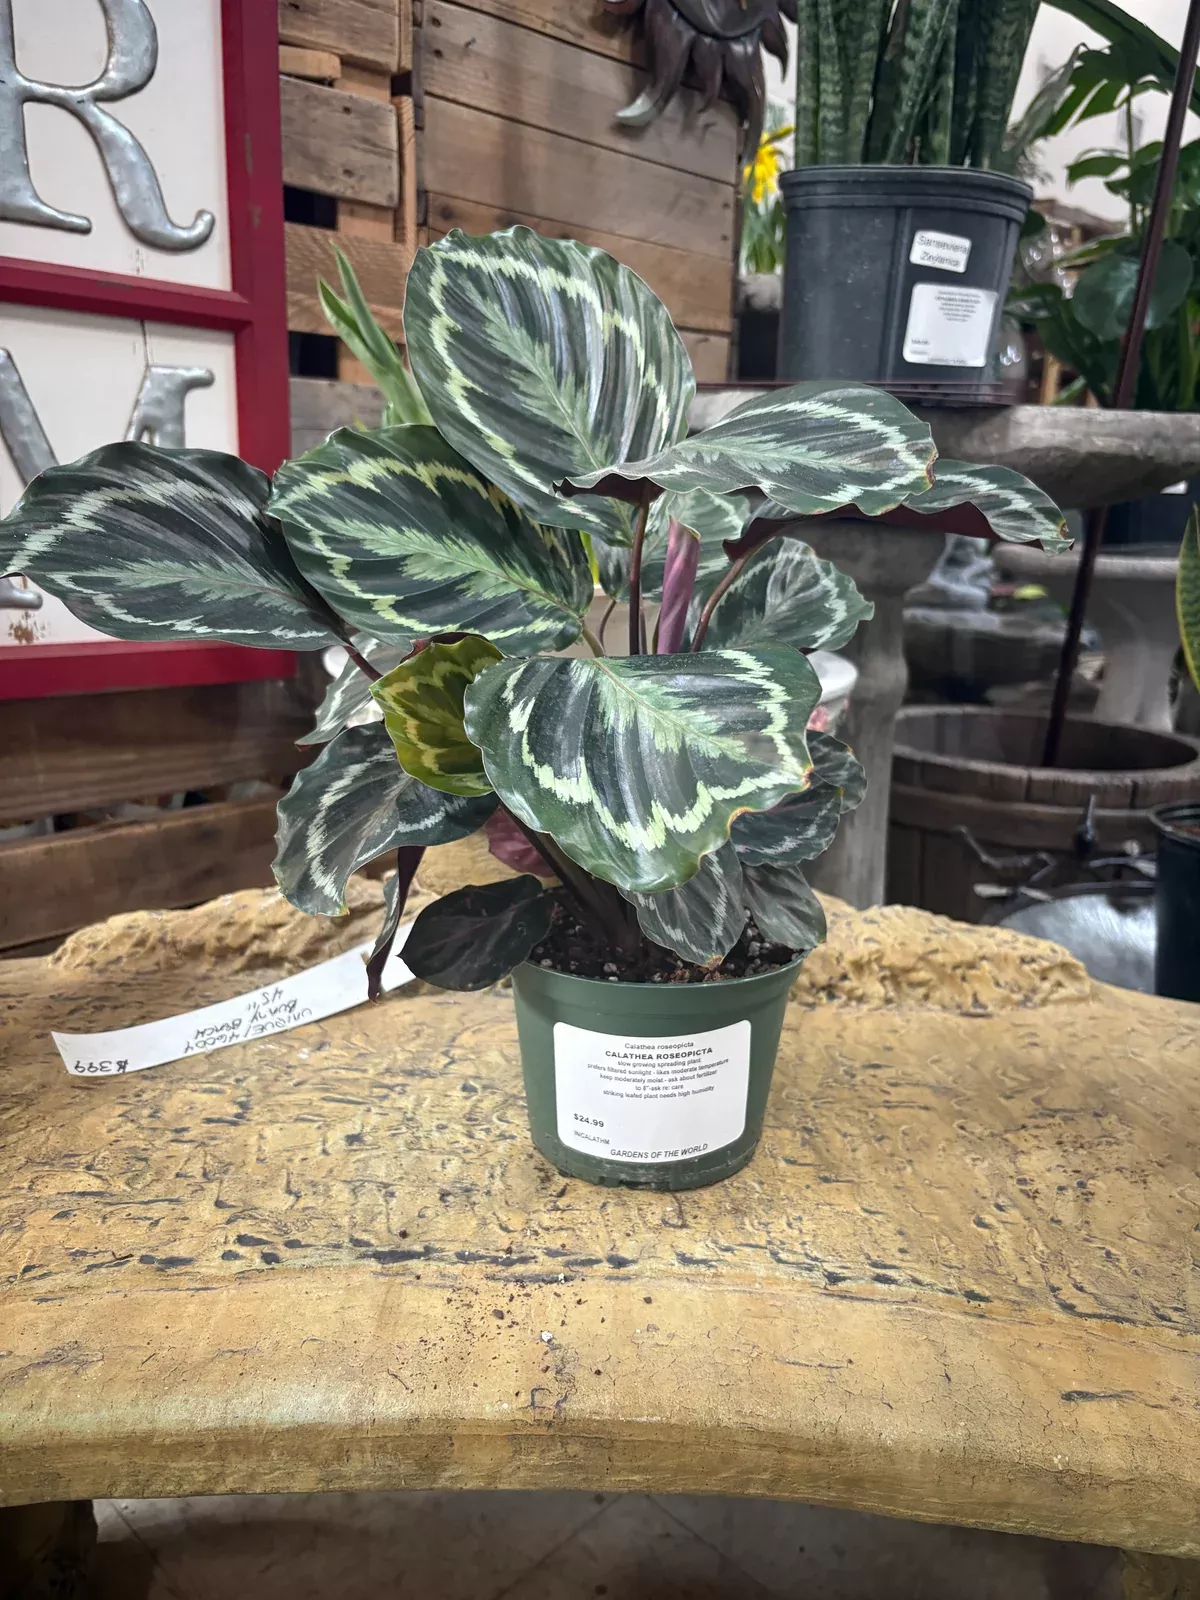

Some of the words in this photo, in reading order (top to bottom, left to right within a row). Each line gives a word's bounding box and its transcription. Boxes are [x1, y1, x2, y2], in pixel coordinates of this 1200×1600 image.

[624, 1042, 656, 1050] Calathea
[605, 1050, 654, 1060] CALATHEA
[656, 1047, 713, 1060] ROSEOPICTA
[587, 1063, 606, 1071] prefers
[607, 1066, 627, 1074] filtered
[671, 1066, 698, 1074] moderate
[698, 1058, 729, 1071] temperature
[657, 1060, 686, 1068] spreading
[599, 1073, 613, 1081] keep
[613, 1076, 646, 1084] moderately
[696, 1069, 717, 1078] fertilizer
[603, 1090, 624, 1098] striking
[678, 1090, 691, 1098] high
[691, 1085, 715, 1095] humidity
[573, 1113, 605, 1128] $24.99
[610, 1148, 649, 1159] GARDENS
[650, 1151, 662, 1159] OF
[664, 1149, 680, 1157] THE
[681, 1143, 709, 1156] WORLD
